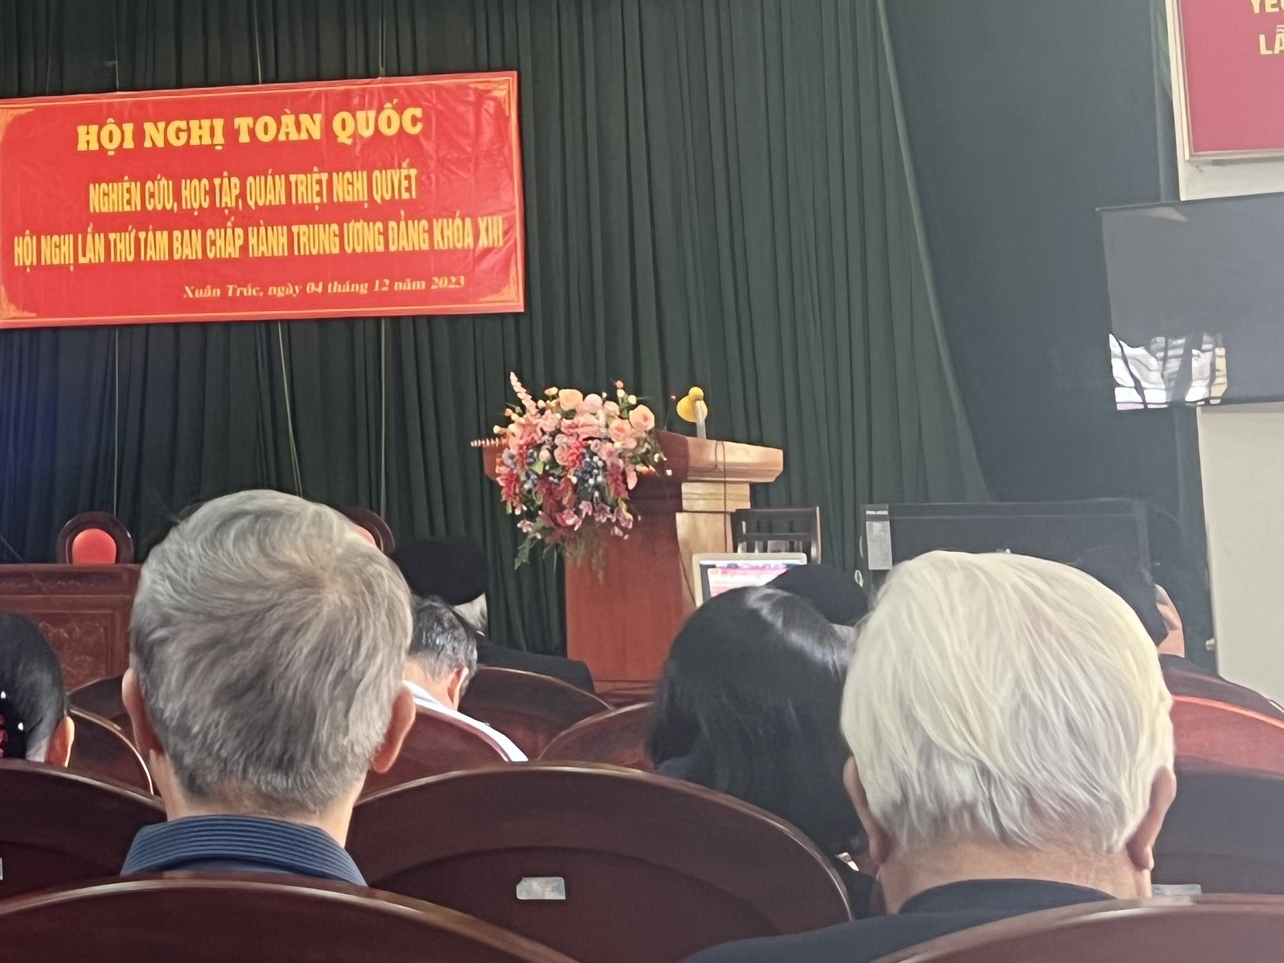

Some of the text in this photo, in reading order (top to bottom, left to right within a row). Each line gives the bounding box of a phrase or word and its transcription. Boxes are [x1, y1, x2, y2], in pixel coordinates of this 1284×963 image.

[77, 98, 423, 156] HỘI NGHỊ TOÀN QUỐC
[89, 158, 418, 216] NGHIÊN CỨU, HỌC TẬP, QUÁN TRIỆT NGHỊ QUYẾT
[14, 210, 504, 273] HỘI NGHỊ LẦN THỨ TÁM BAN CHẤP HÀNH TRUNG ƯƠNG ĐẢNG KHÓA XIII
[268, 282, 302, 297] ngày
[374, 278, 390, 292] 12
